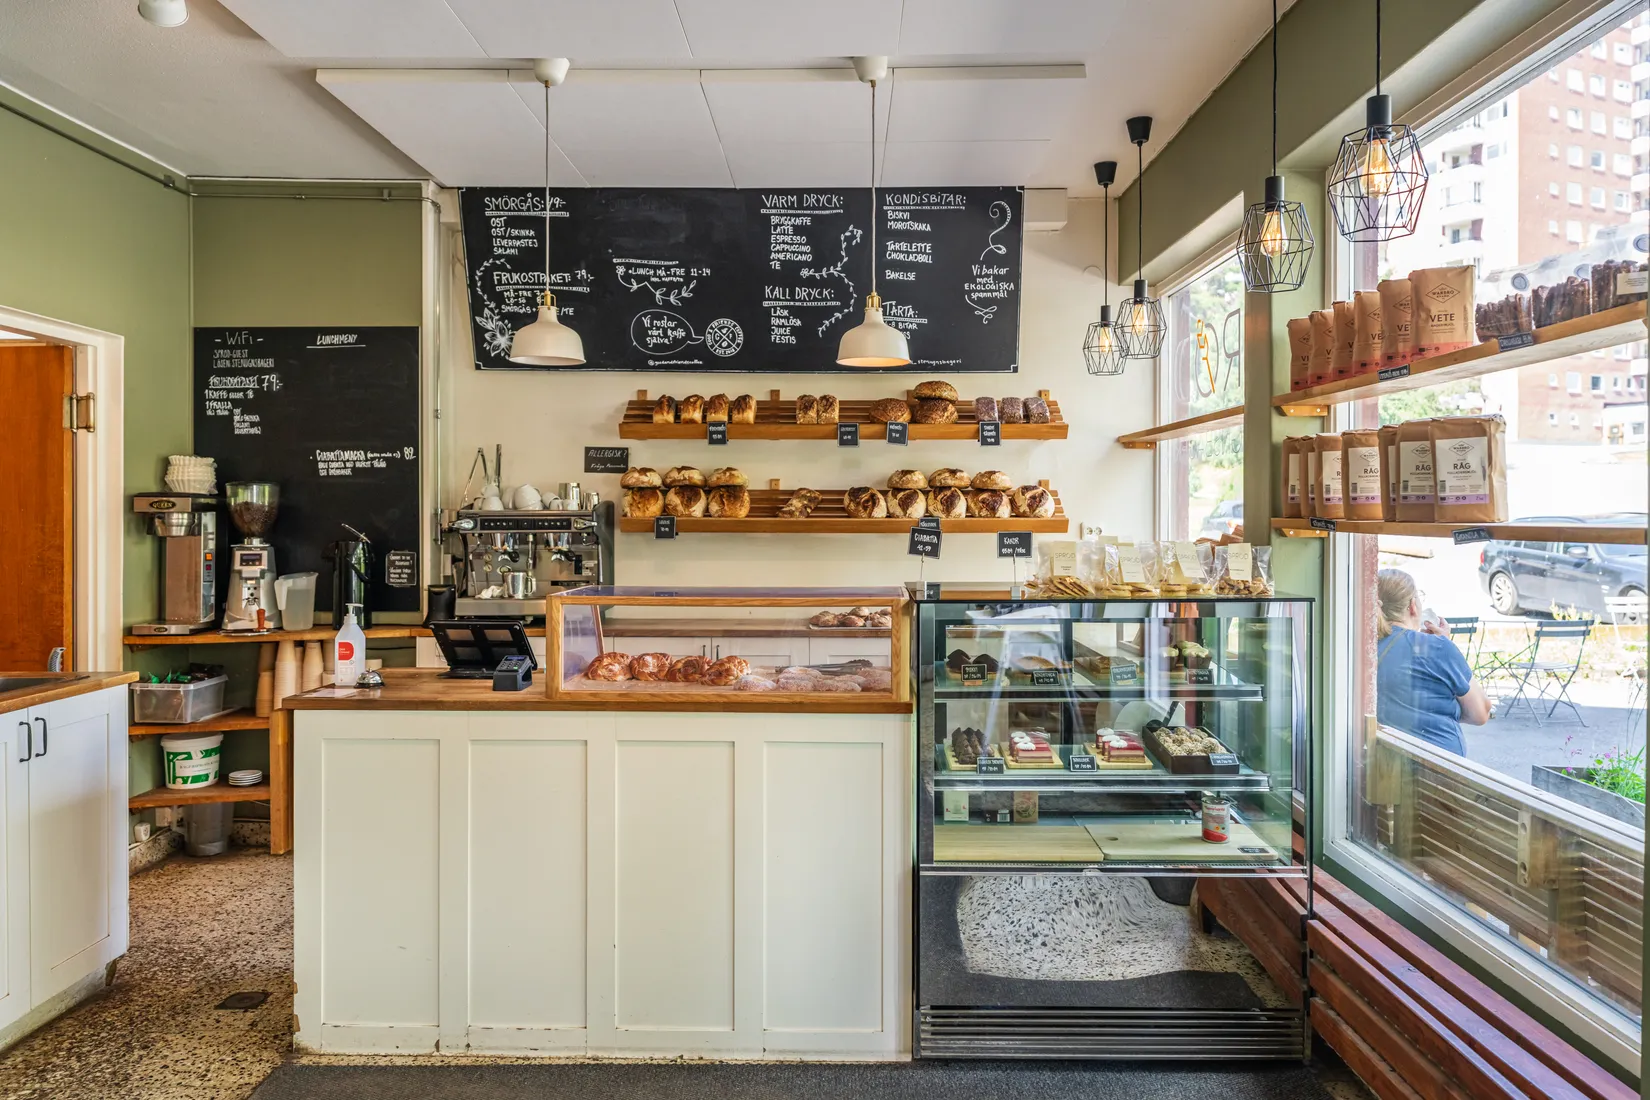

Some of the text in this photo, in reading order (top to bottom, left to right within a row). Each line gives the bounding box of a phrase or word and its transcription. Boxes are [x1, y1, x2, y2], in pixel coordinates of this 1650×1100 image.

[484, 192, 544, 211] SMÖRGÅS:
[762, 193, 843, 208] VARM DRYCK:
[887, 210, 910, 220] BISKVI
[490, 217, 507, 227] OST
[770, 215, 812, 226] BRYGGKAFFE
[771, 226, 793, 234] LATTE
[887, 221, 931, 231] MOROTSKAKA
[493, 238, 538, 247] LEVERPASTEJ
[771, 235, 807, 243] ESPRESSO
[493, 247, 518, 255] SALAMI
[770, 244, 811, 253] CAPPUCCINO
[886, 241, 932, 253] TARTELETTE
[770, 252, 812, 261] AMERICANO
[886, 251, 933, 263] CHOKLADBOLL
[769, 261, 781, 270] TE
[972, 264, 1009, 276] Vi bakar
[631, 267, 711, 276] LUNCH MÅ-FRE 11-14
[885, 269, 916, 281] BAKELSE
[976, 275, 993, 284] med
[765, 285, 835, 301] KALL DRYCK:
[971, 289, 1008, 300] spannmål
[771, 307, 789, 317] LÄSK
[653, 316, 677, 327] rostar
[771, 316, 802, 327] RAMLÖSA
[1430, 313, 1455, 322] VETE
[771, 327, 791, 335] JUICE
[898, 322, 918, 330] BITAR
[316, 333, 358, 345] LUNCHMENY
[771, 335, 797, 344] FESTIS
[1363, 467, 1380, 475] RÅG
[1453, 462, 1471, 470] RÅG
